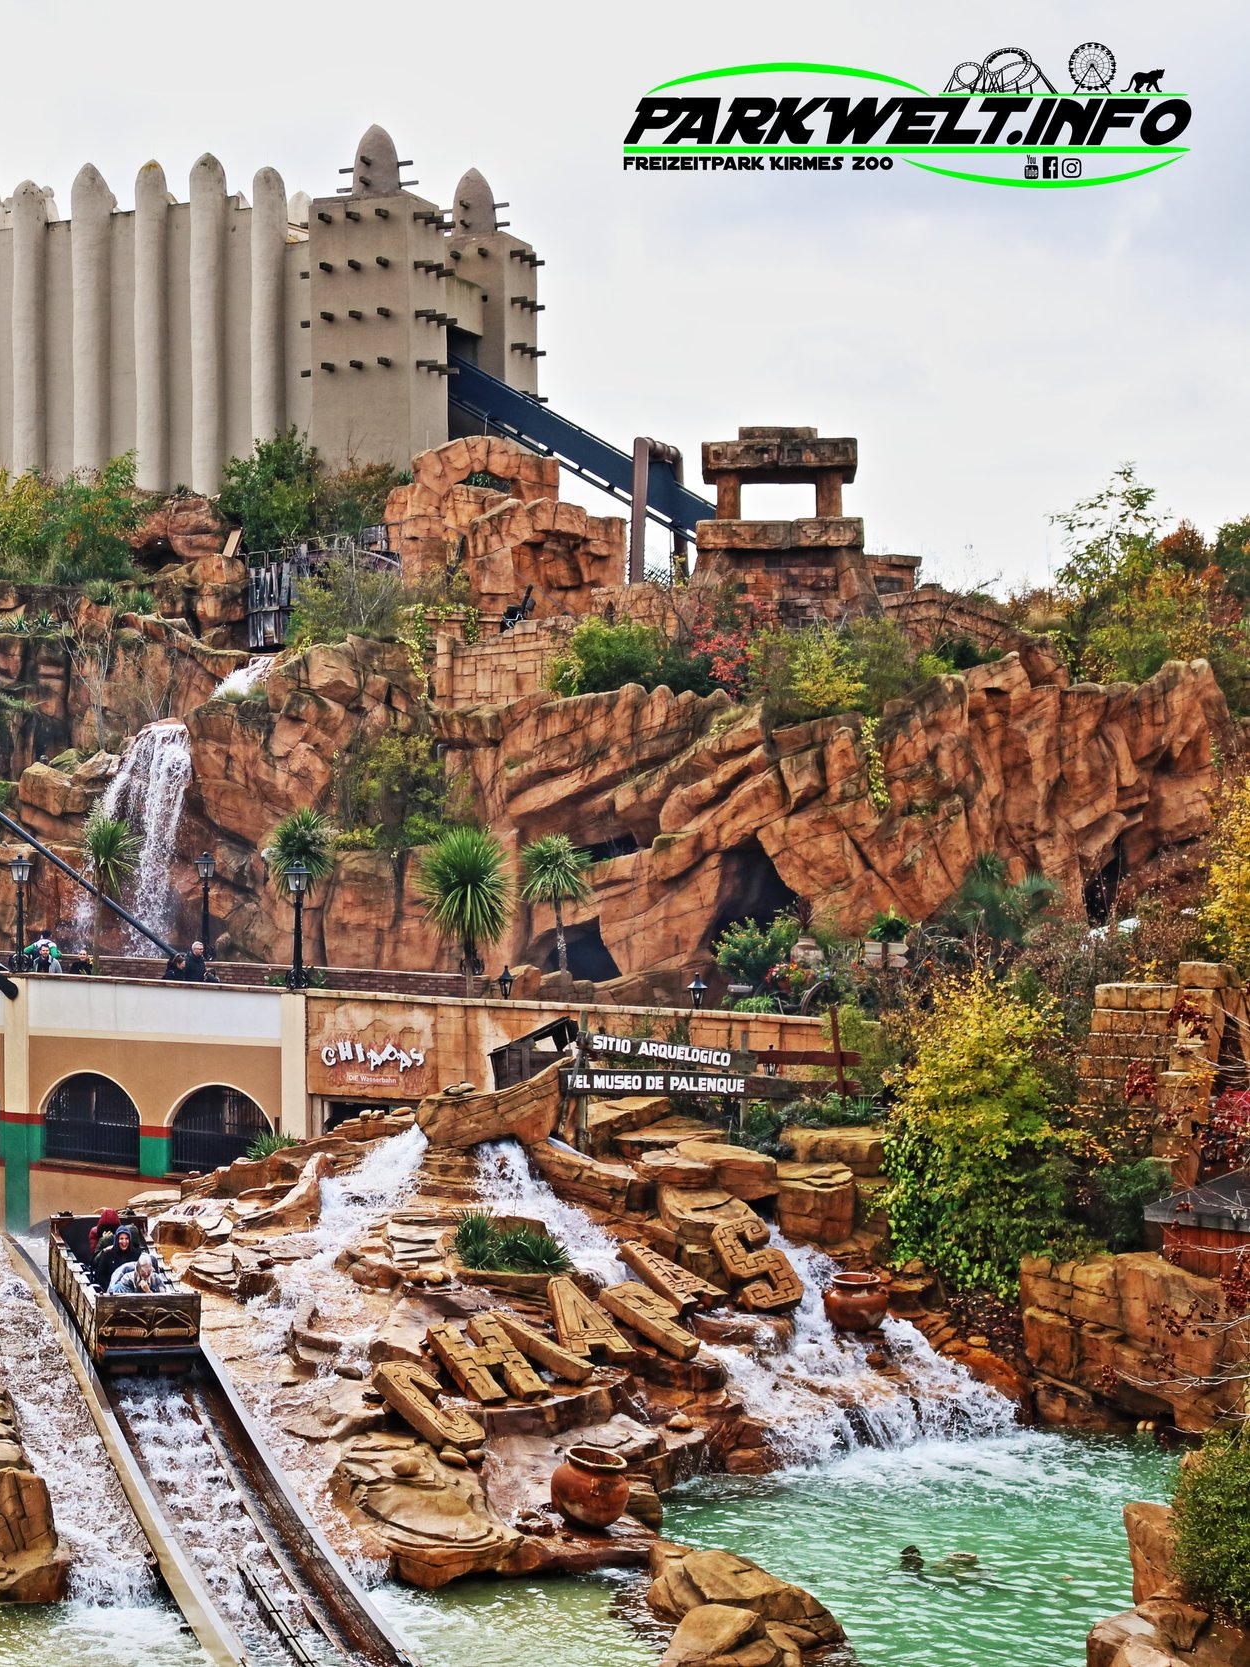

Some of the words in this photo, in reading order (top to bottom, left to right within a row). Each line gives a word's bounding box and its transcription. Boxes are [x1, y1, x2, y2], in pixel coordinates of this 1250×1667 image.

[321, 1040, 425, 1073] CHIAPAS
[593, 1035, 632, 1054] SITIO
[638, 1042, 731, 1066] ARQUELOGICO
[360, 1075, 397, 1084] Wasserbahn
[593, 1074, 642, 1090] MUSEO
[645, 1075, 664, 1091] DE
[669, 1076, 745, 1094] PALENQUE
